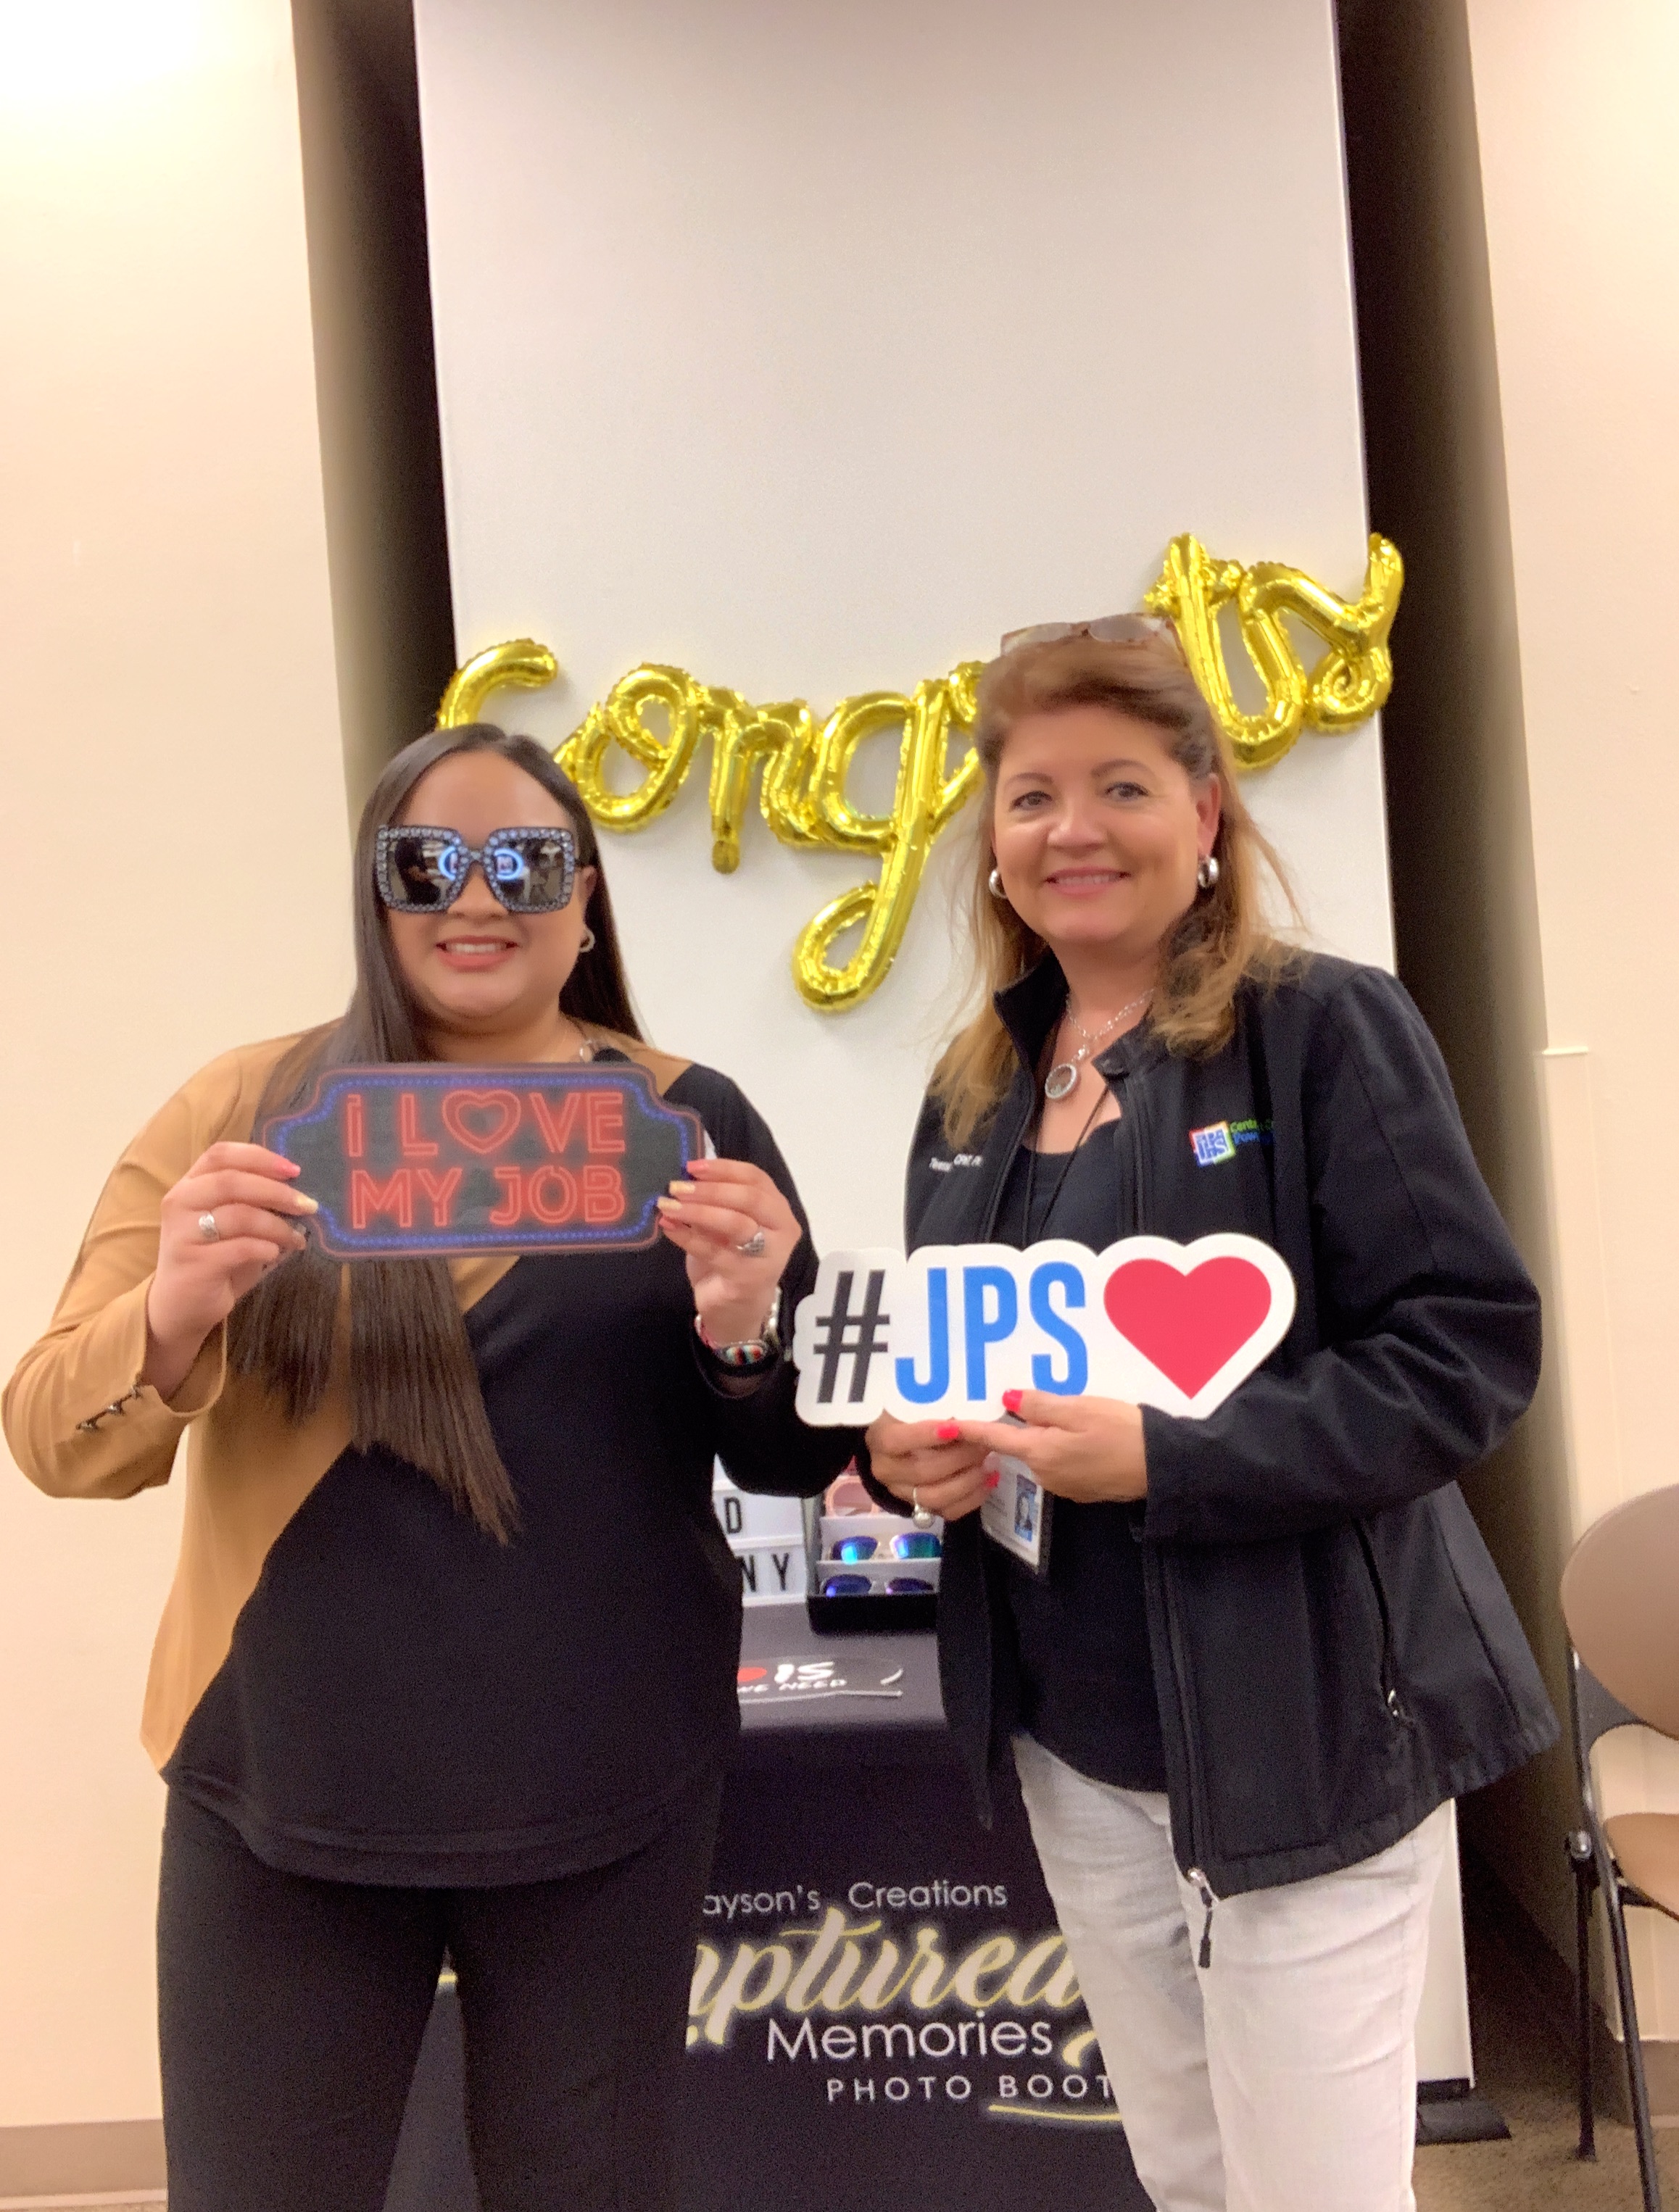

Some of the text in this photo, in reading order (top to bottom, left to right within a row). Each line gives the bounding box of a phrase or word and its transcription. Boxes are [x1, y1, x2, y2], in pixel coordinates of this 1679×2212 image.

[347, 1093, 362, 1157] I
[350, 1164, 626, 1229] MY JOB
[813, 1260, 1089, 1405] #JPS
[848, 1879, 1008, 1910] Creations
[766, 2010, 1053, 2061] Memories
[826, 2075, 972, 2102] PHOTO
